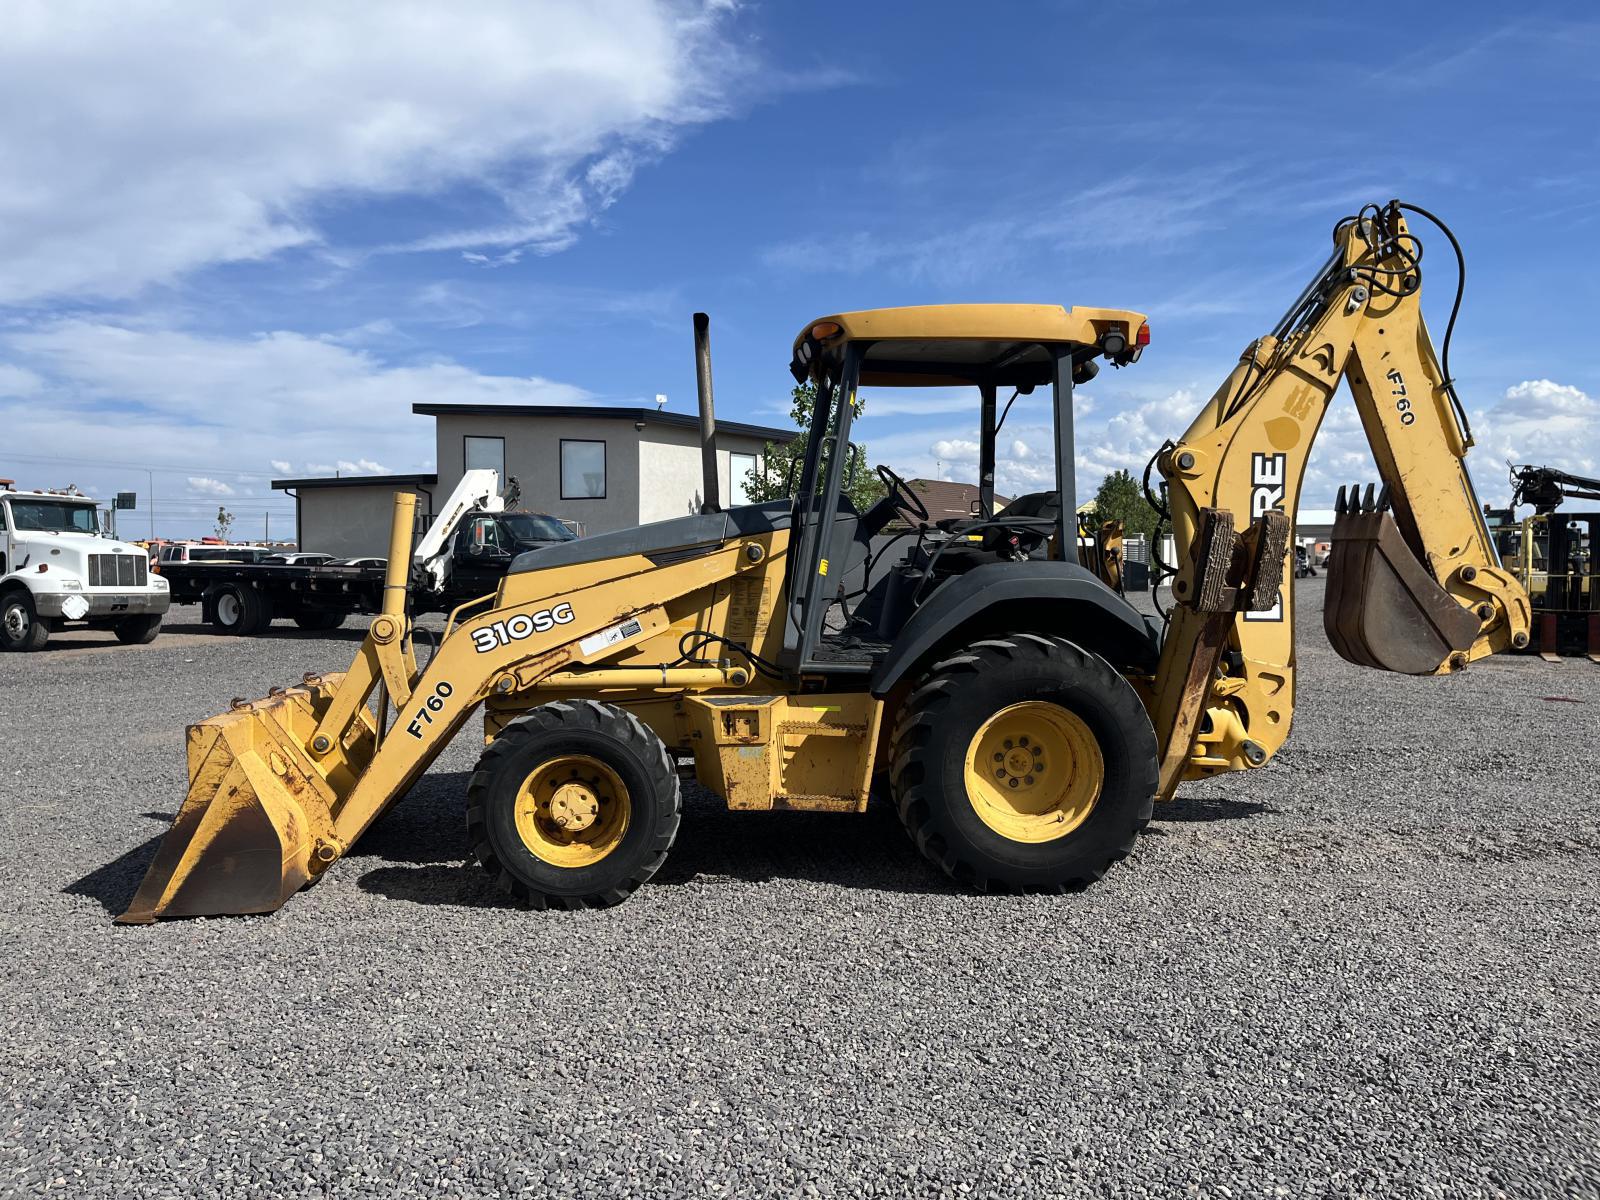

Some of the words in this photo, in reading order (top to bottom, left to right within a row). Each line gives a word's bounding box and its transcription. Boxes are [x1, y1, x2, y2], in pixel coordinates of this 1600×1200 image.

[1386, 371, 1416, 426] F760
[472, 603, 575, 653] 310SG
[405, 680, 454, 740] F760
